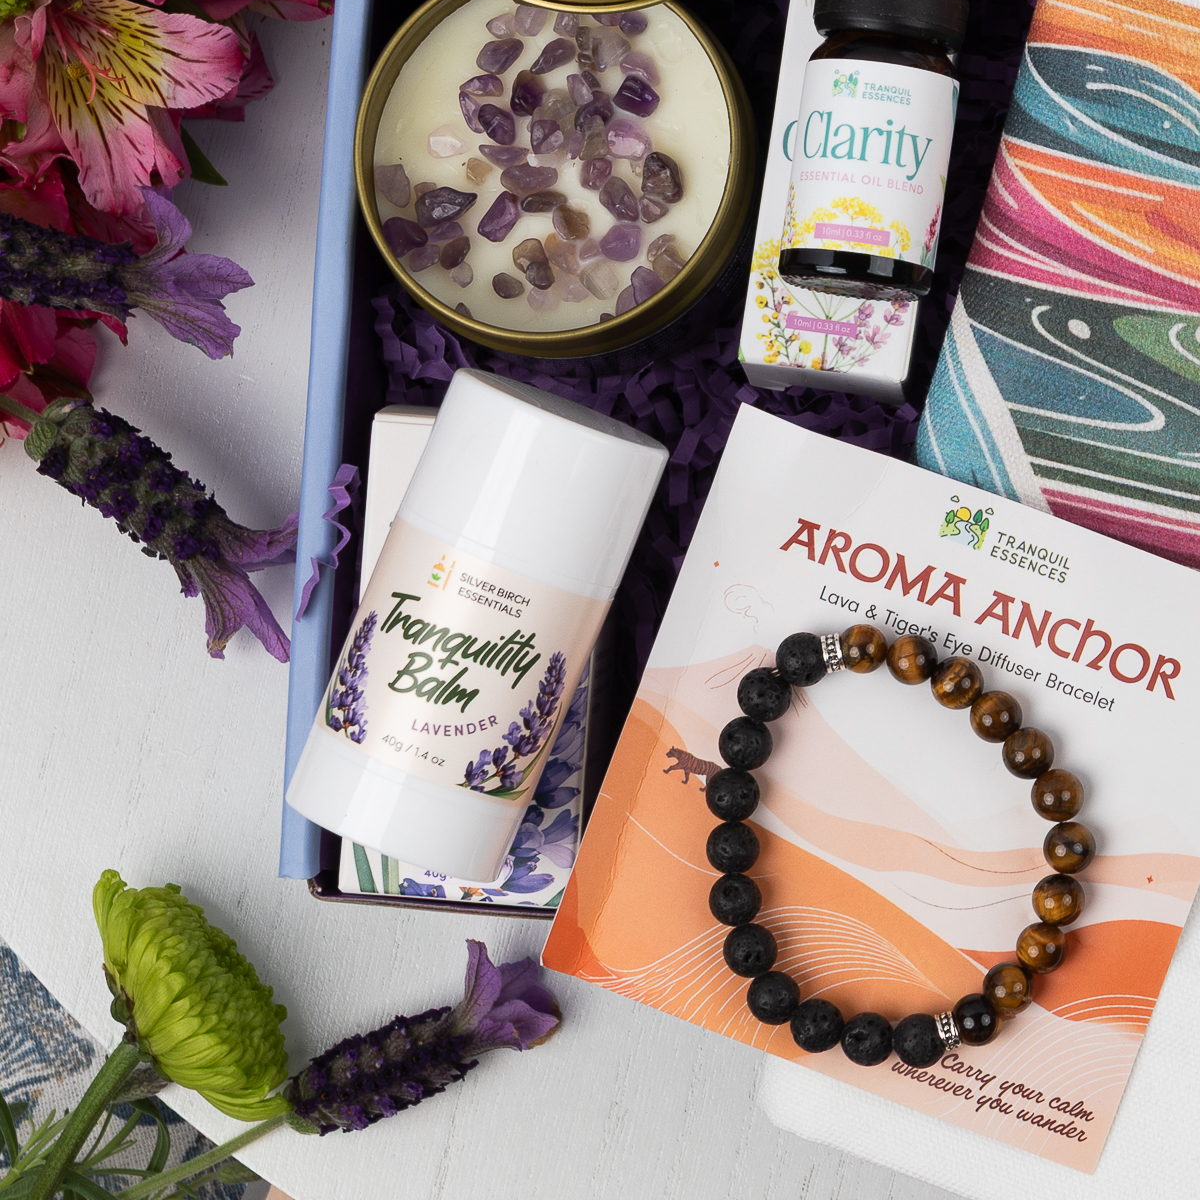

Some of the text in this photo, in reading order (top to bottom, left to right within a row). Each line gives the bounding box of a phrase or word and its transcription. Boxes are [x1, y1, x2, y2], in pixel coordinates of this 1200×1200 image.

[862, 91, 911, 106] ESSENCES
[863, 82, 912, 97] TRANQUIL
[803, 110, 933, 181] Clarity
[800, 171, 924, 195] ESSENTIAL OIL BLEND
[822, 227, 840, 237] 10ml
[846, 228, 865, 239] 0.33
[793, 318, 812, 328] 10ml
[816, 321, 834, 331] 0.33
[780, 518, 967, 617] AROMA
[990, 546, 1067, 583] ESSENCES
[996, 531, 1071, 570] TRANQUIL
[457, 586, 523, 619] ESSENTIALS
[459, 572, 531, 607] SILVER BIRCH
[380, 591, 542, 689] Tranquility
[819, 585, 1116, 712] Lava & Tiger's Eye Diffuser Bracelet
[388, 652, 480, 713] Balm
[411, 715, 499, 737] LAVENDER
[382, 734, 404, 752] 40g
[415, 747, 428, 760] 1.4
[431, 756, 446, 767] oz
[891, 1061, 1088, 1142] wherever you wander
[940, 1052, 1095, 1122] Carry your calm
